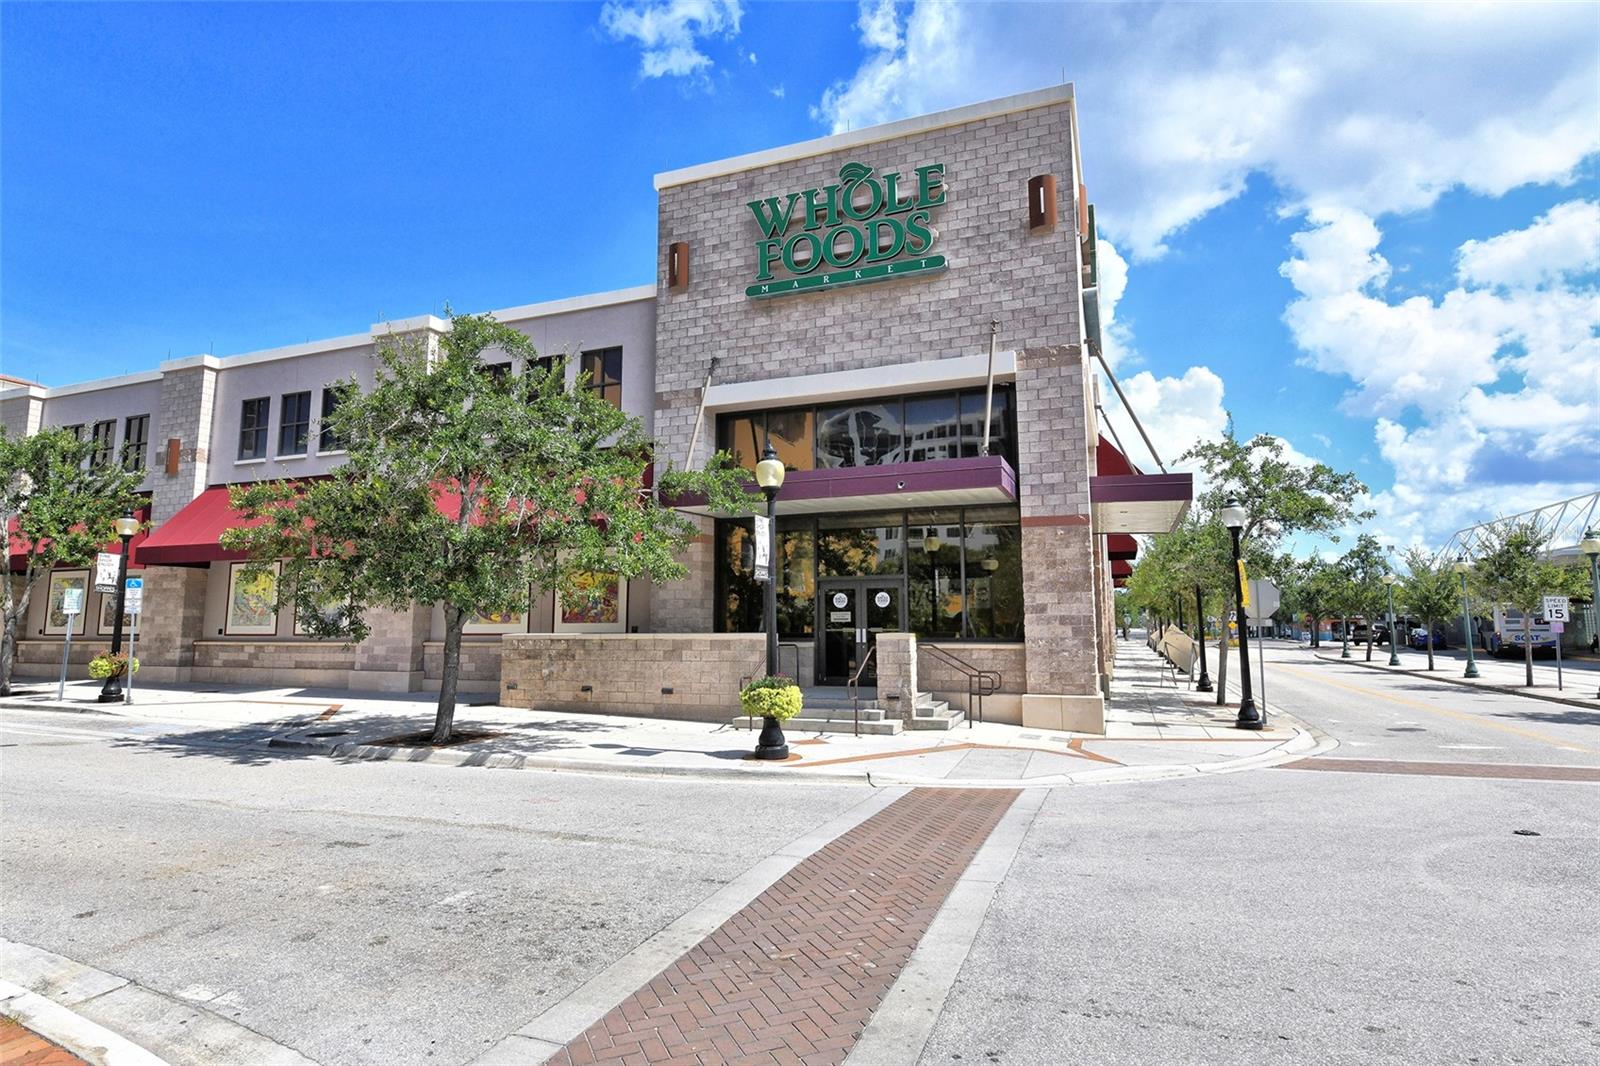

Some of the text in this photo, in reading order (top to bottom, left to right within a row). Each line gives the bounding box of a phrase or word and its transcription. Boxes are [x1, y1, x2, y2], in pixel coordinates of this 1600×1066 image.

[747, 164, 946, 237] WHOLE
[755, 212, 933, 280] FOODS
[761, 260, 927, 292] MARKET
[1549, 609, 1564, 619] 15
